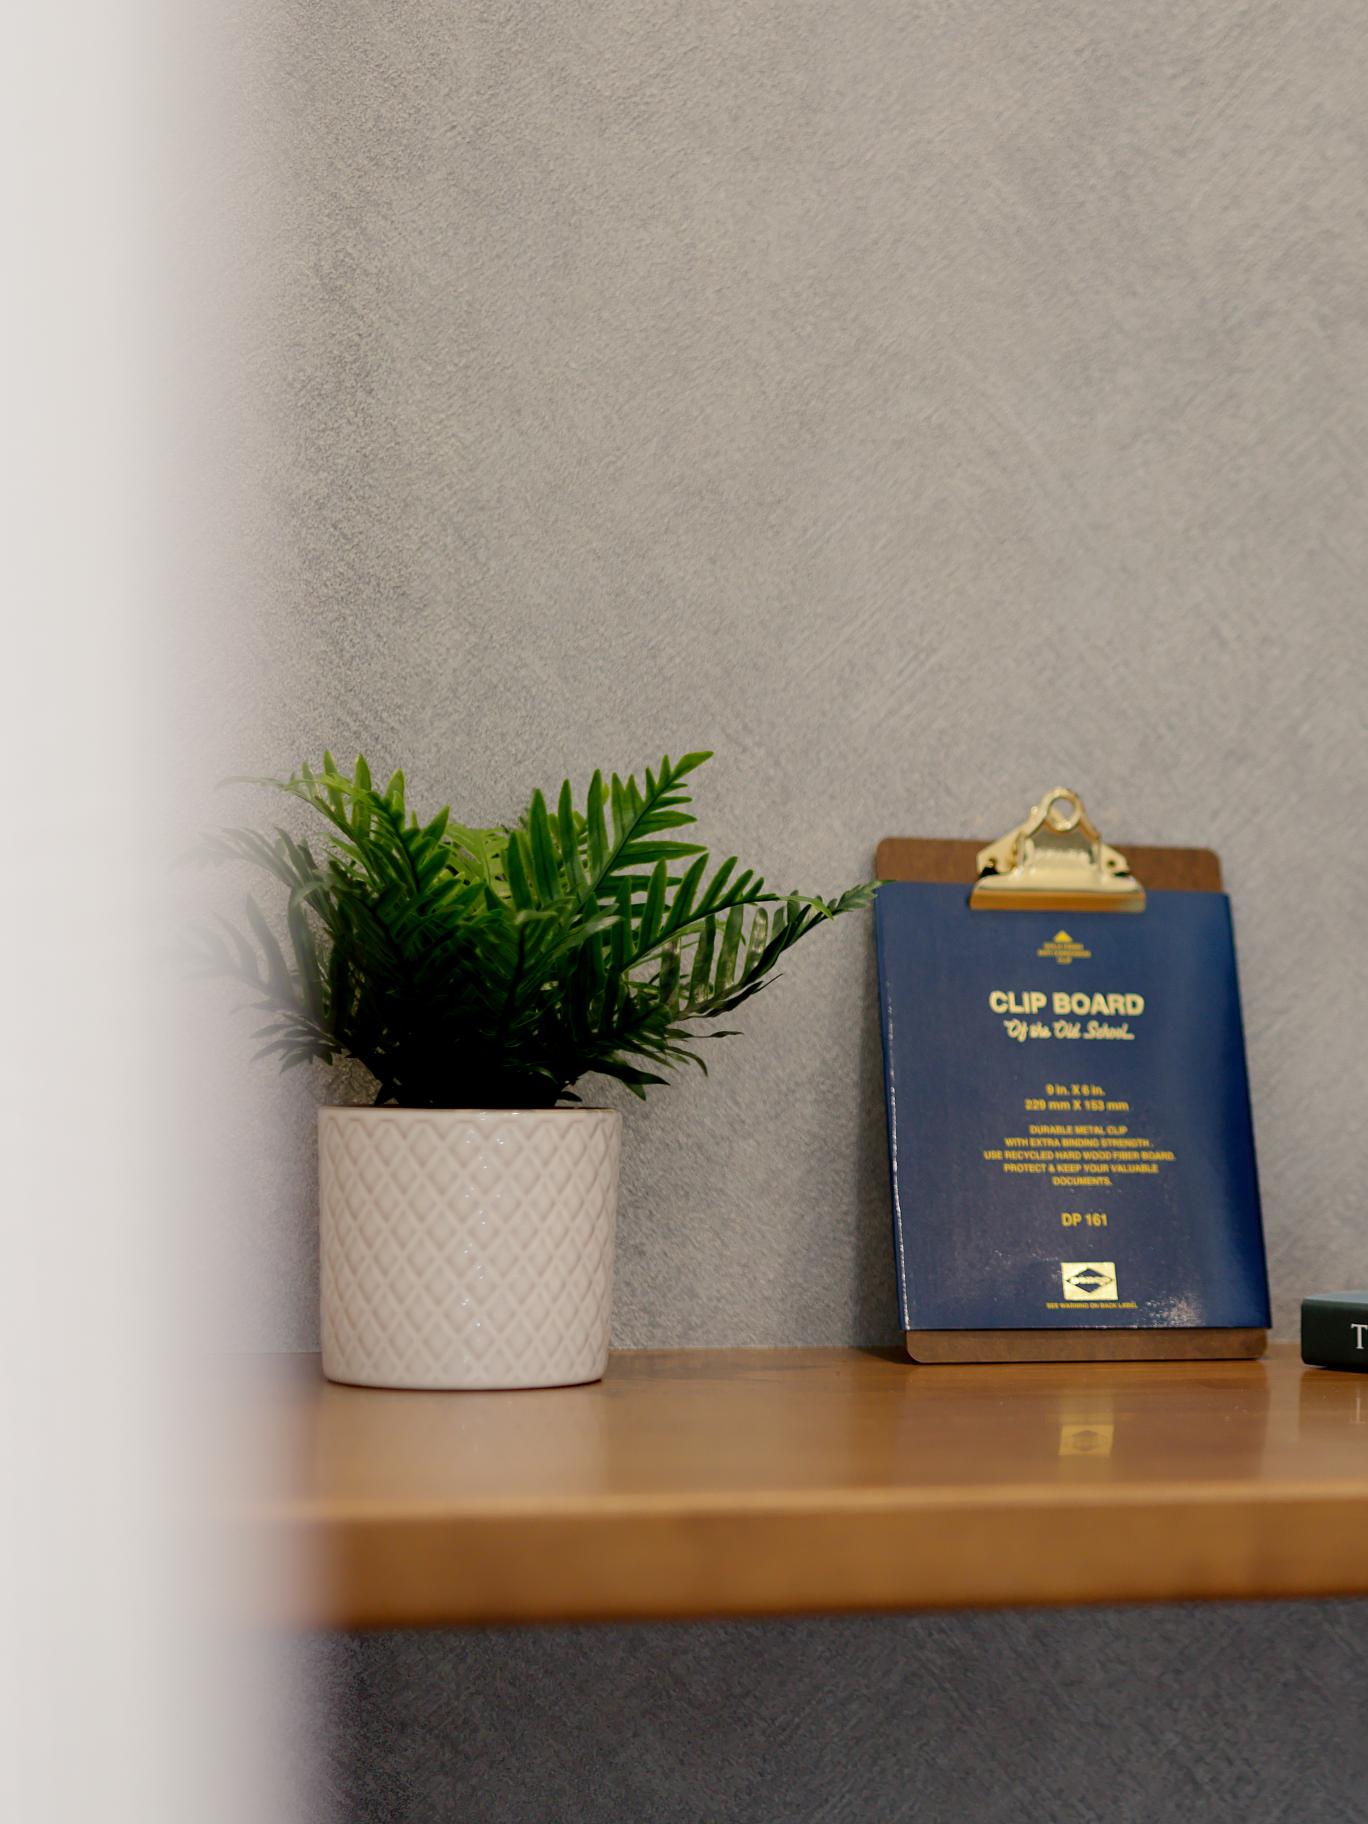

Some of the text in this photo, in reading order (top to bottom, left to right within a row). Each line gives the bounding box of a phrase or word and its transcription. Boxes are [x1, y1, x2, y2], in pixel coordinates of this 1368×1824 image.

[989, 990, 1145, 1016] CLIP BOARD
[1003, 1018, 1135, 1042] Of the Old School
[1056, 1083, 1071, 1096] in.
[1091, 1084, 1106, 1096] in.
[1024, 1098, 1047, 1111] 229
[1048, 1101, 1071, 1111] mm
[1106, 1101, 1129, 1112] mm
[1028, 1125, 1128, 1135] DURABLE METAL CLIP
[1004, 1137, 1028, 1147] WITH
[1029, 1137, 1061, 1147] EXTRA
[1062, 1137, 1100, 1148] BINDING
[983, 1150, 1003, 1160] USE
[1004, 1150, 1054, 1160] RECYCLED
[1055, 1151, 1082, 1160] HARD
[1083, 1151, 1112, 1160] WOOD
[1003, 1163, 1159, 1174] PROTECT & KEEP YOUR VALUABLE
[1061, 1212, 1108, 1228] DP 161
